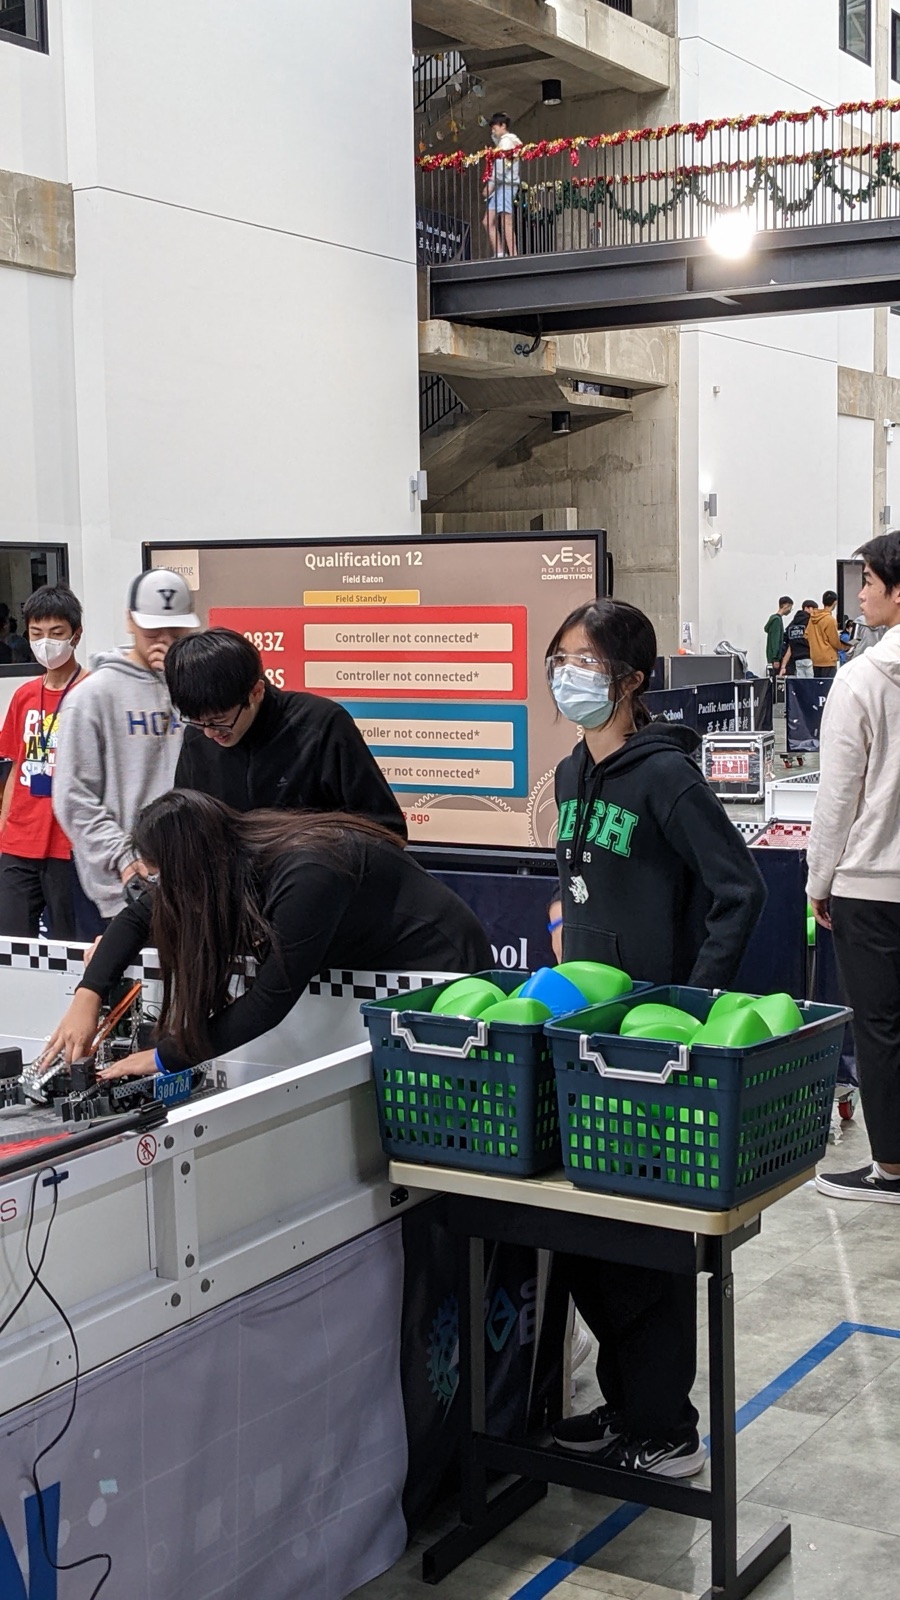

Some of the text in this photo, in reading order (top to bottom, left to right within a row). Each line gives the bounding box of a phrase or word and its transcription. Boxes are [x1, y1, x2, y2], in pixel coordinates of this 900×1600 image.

[304, 551, 423, 571] Qualification 12
[541, 546, 592, 566] VEX
[342, 574, 384, 583] Field Eaton
[156, 588, 178, 610] Y
[355, 594, 388, 605] Standby
[335, 632, 390, 643] Controller
[392, 633, 412, 643] not
[336, 670, 391, 681] Controller
[393, 671, 412, 682] not
[698, 701, 716, 714] Pacific
[717, 700, 742, 712] Amerin
[394, 729, 413, 739] not
[394, 767, 413, 777] not
[410, 814, 430, 824] ago
[157, 1076, 190, 1101] 30078A
